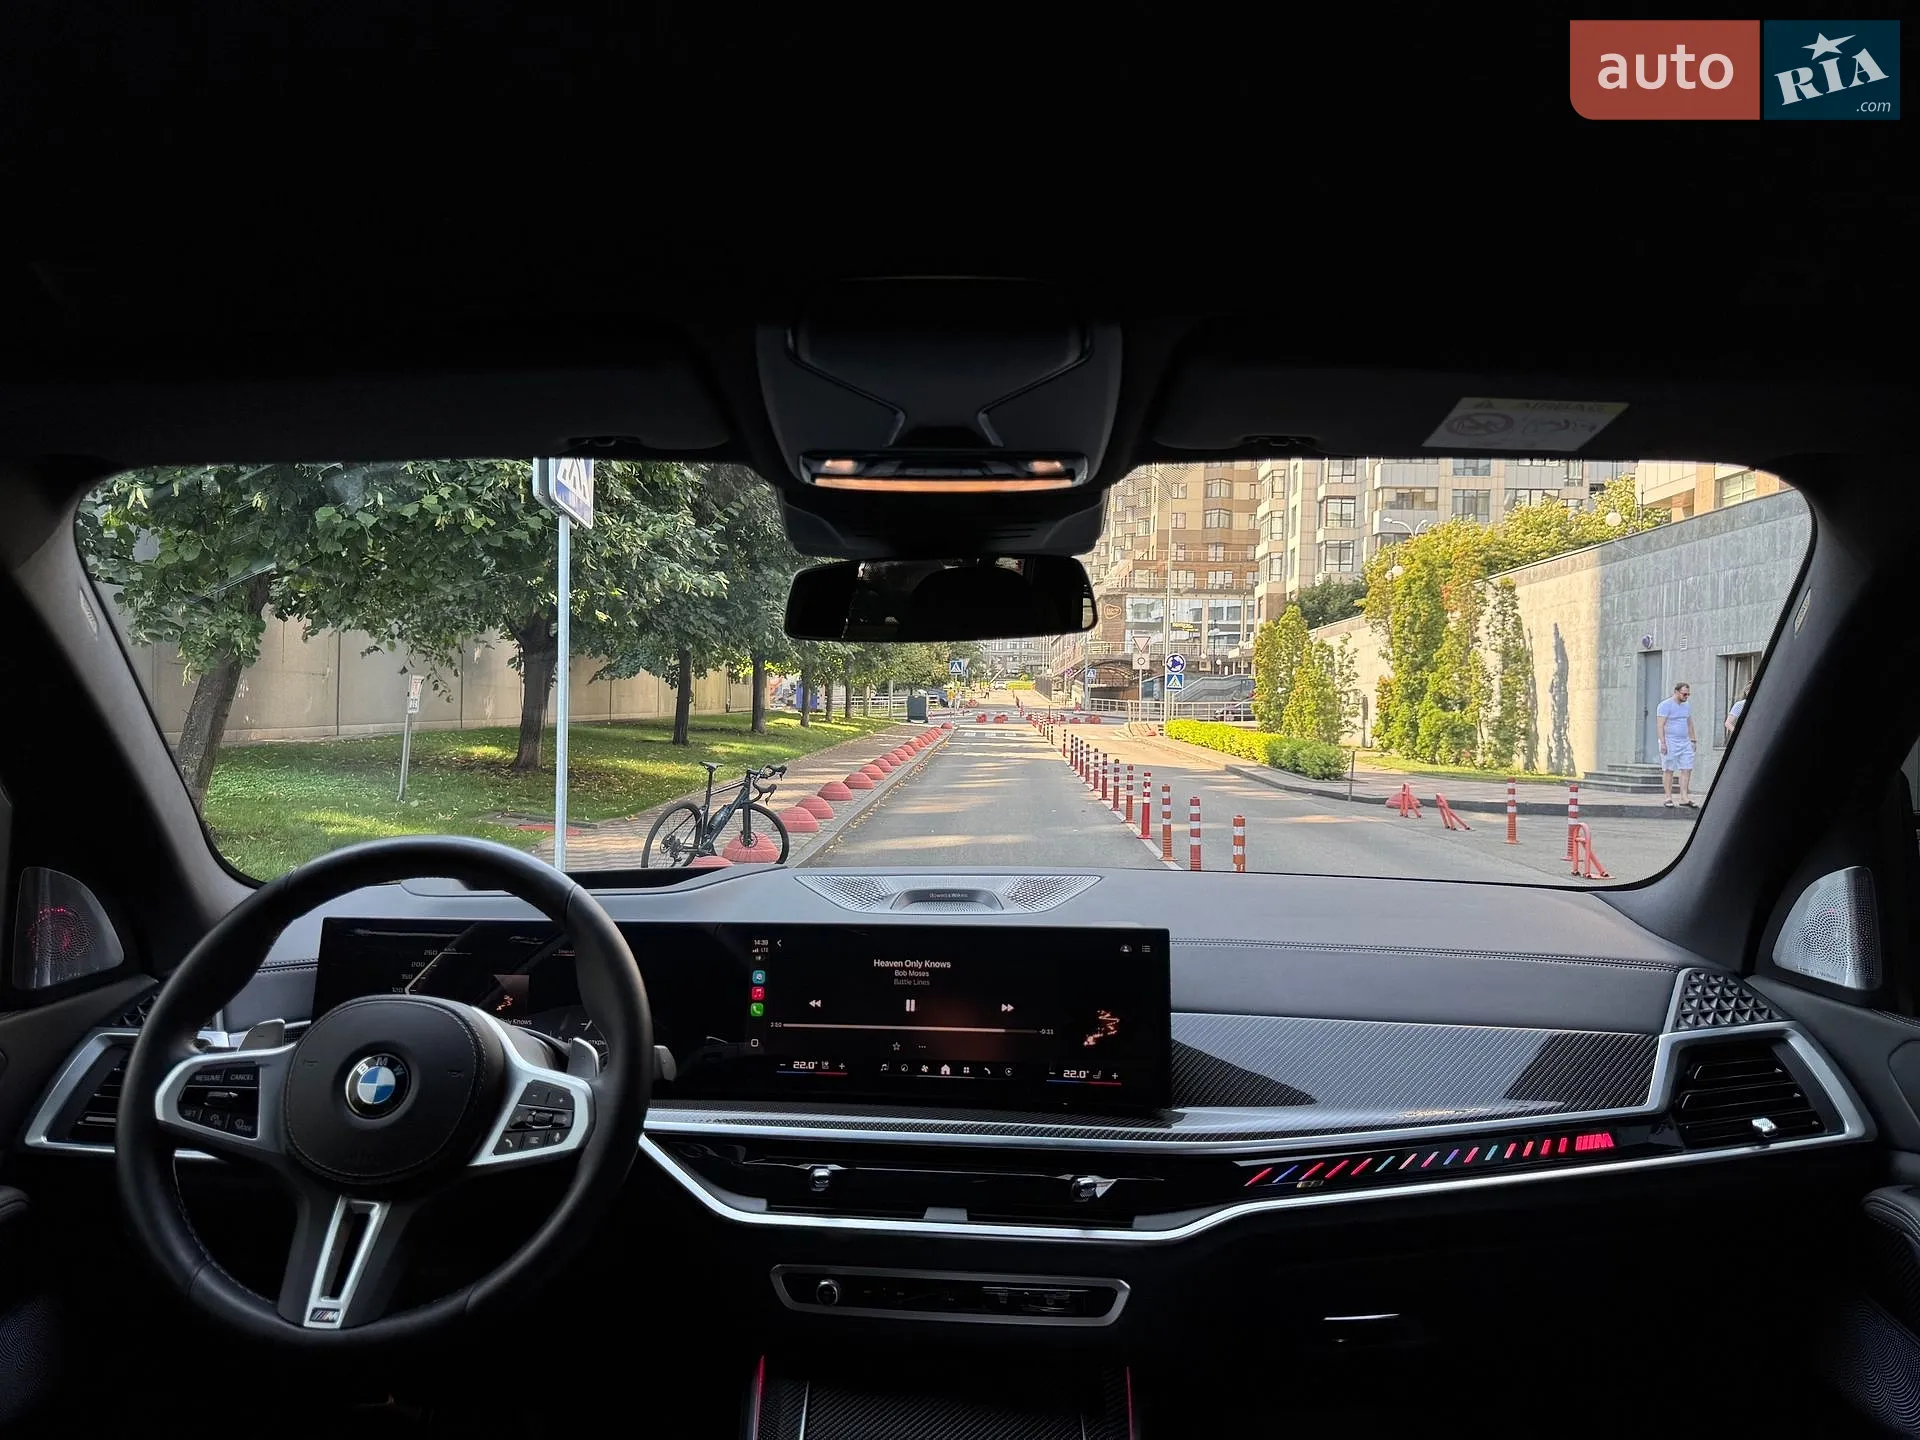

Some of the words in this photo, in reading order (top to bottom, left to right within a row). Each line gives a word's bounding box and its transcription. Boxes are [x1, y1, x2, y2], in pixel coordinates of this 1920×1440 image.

[873, 958, 903, 967] Heaven
[904, 959, 923, 969] Only
[924, 959, 952, 969] Knows
[894, 969, 908, 977] Bob
[908, 969, 930, 977] Moses
[356, 1056, 405, 1077] BMW
[229, 1073, 254, 1081] CANCEL
